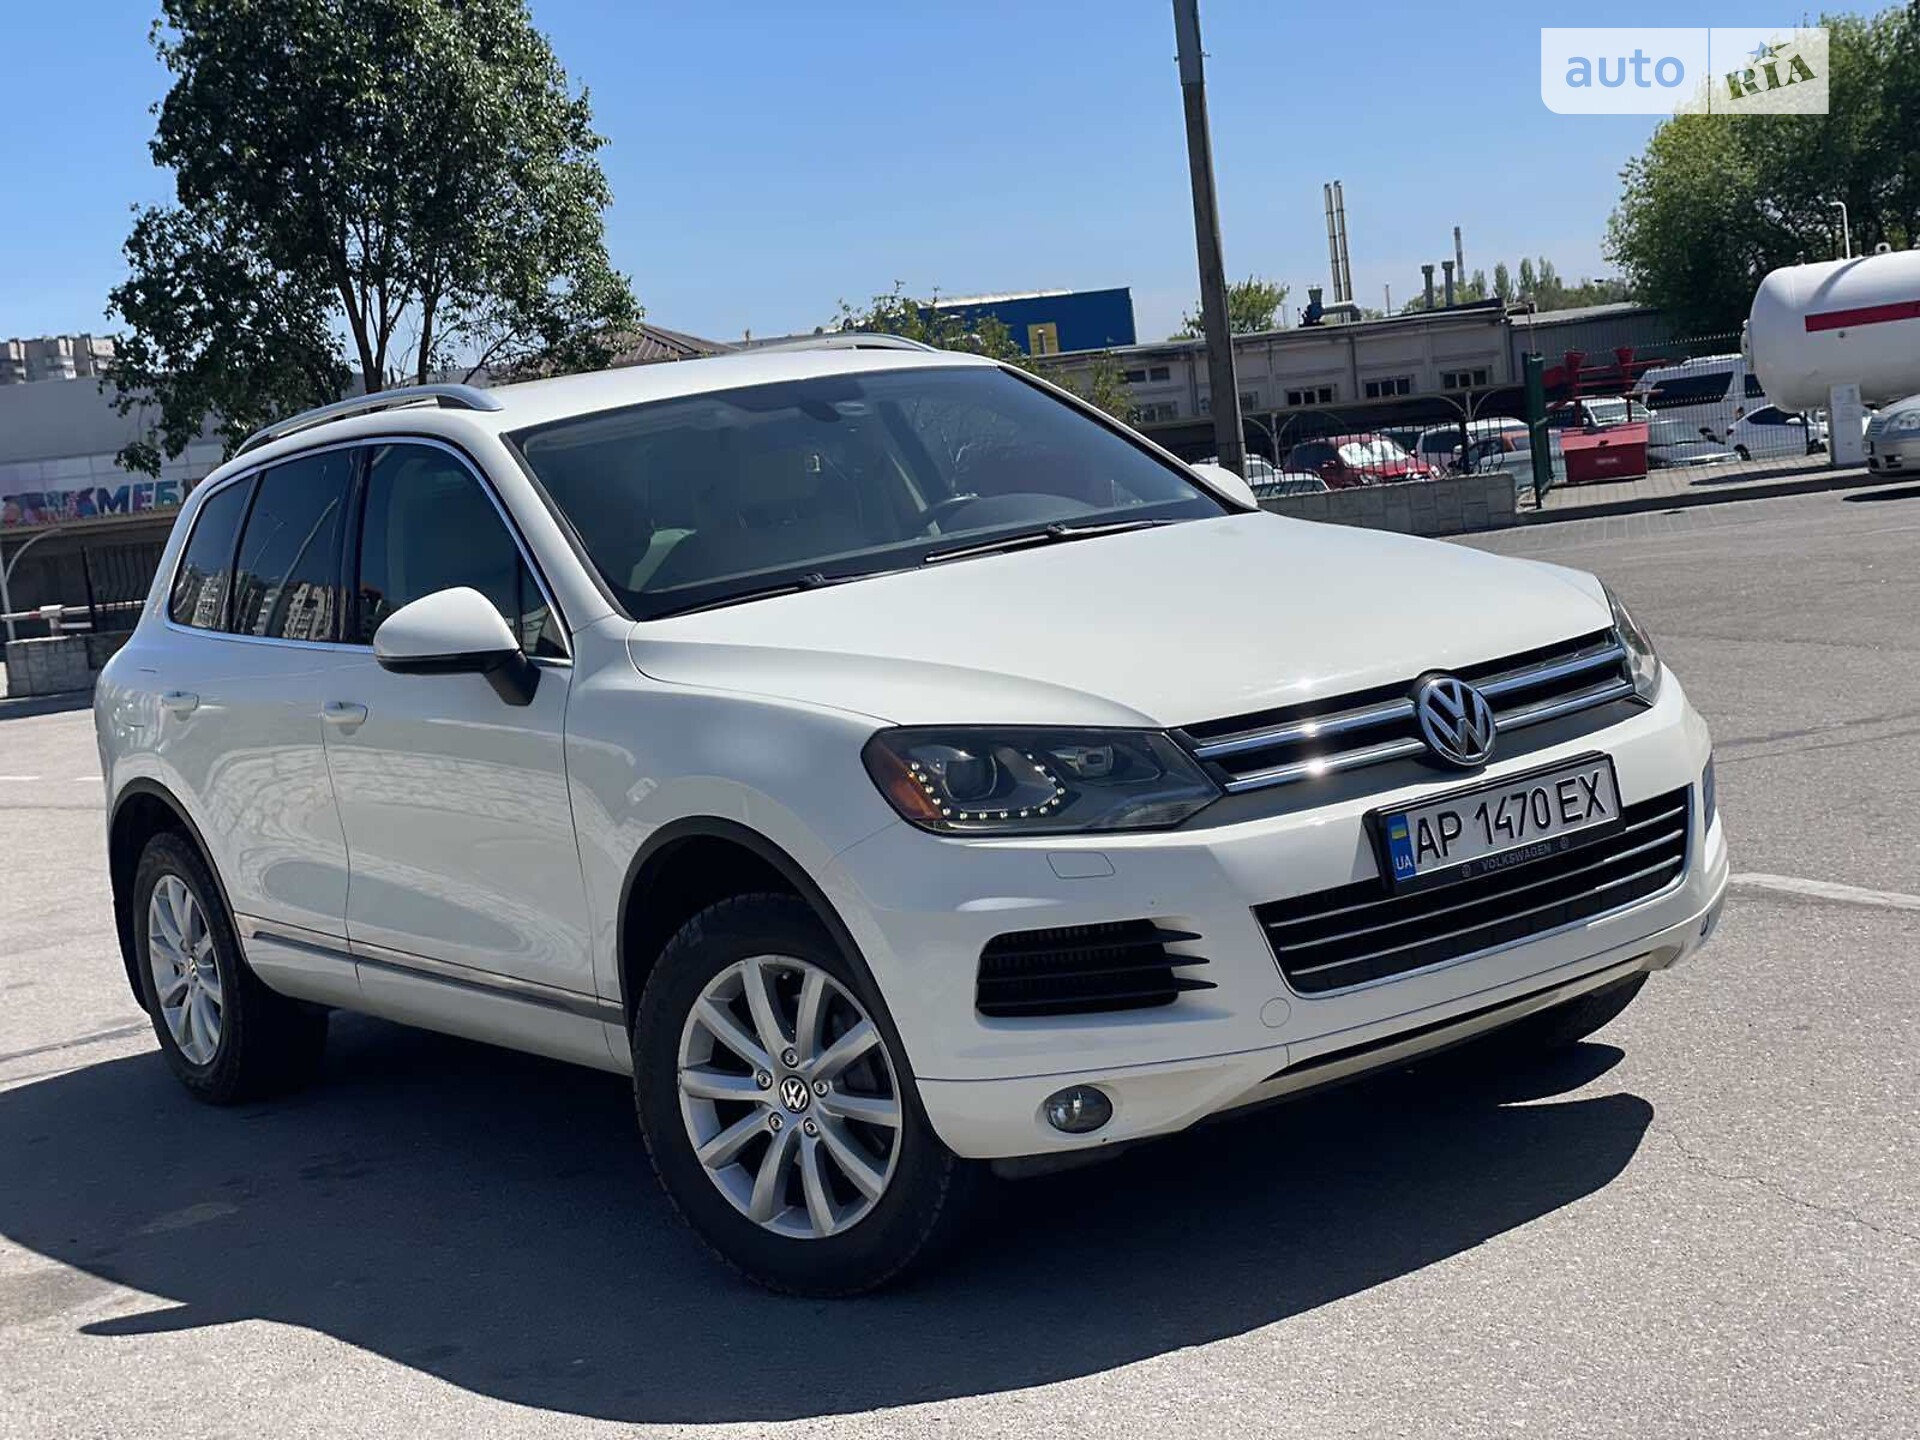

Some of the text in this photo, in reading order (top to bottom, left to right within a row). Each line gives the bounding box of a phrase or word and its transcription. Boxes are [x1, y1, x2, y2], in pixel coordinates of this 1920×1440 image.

[1416, 769, 1608, 864] AP 1470 EX
[1395, 853, 1413, 870] UA
[1481, 842, 1553, 872] VOLKSWAGEN
